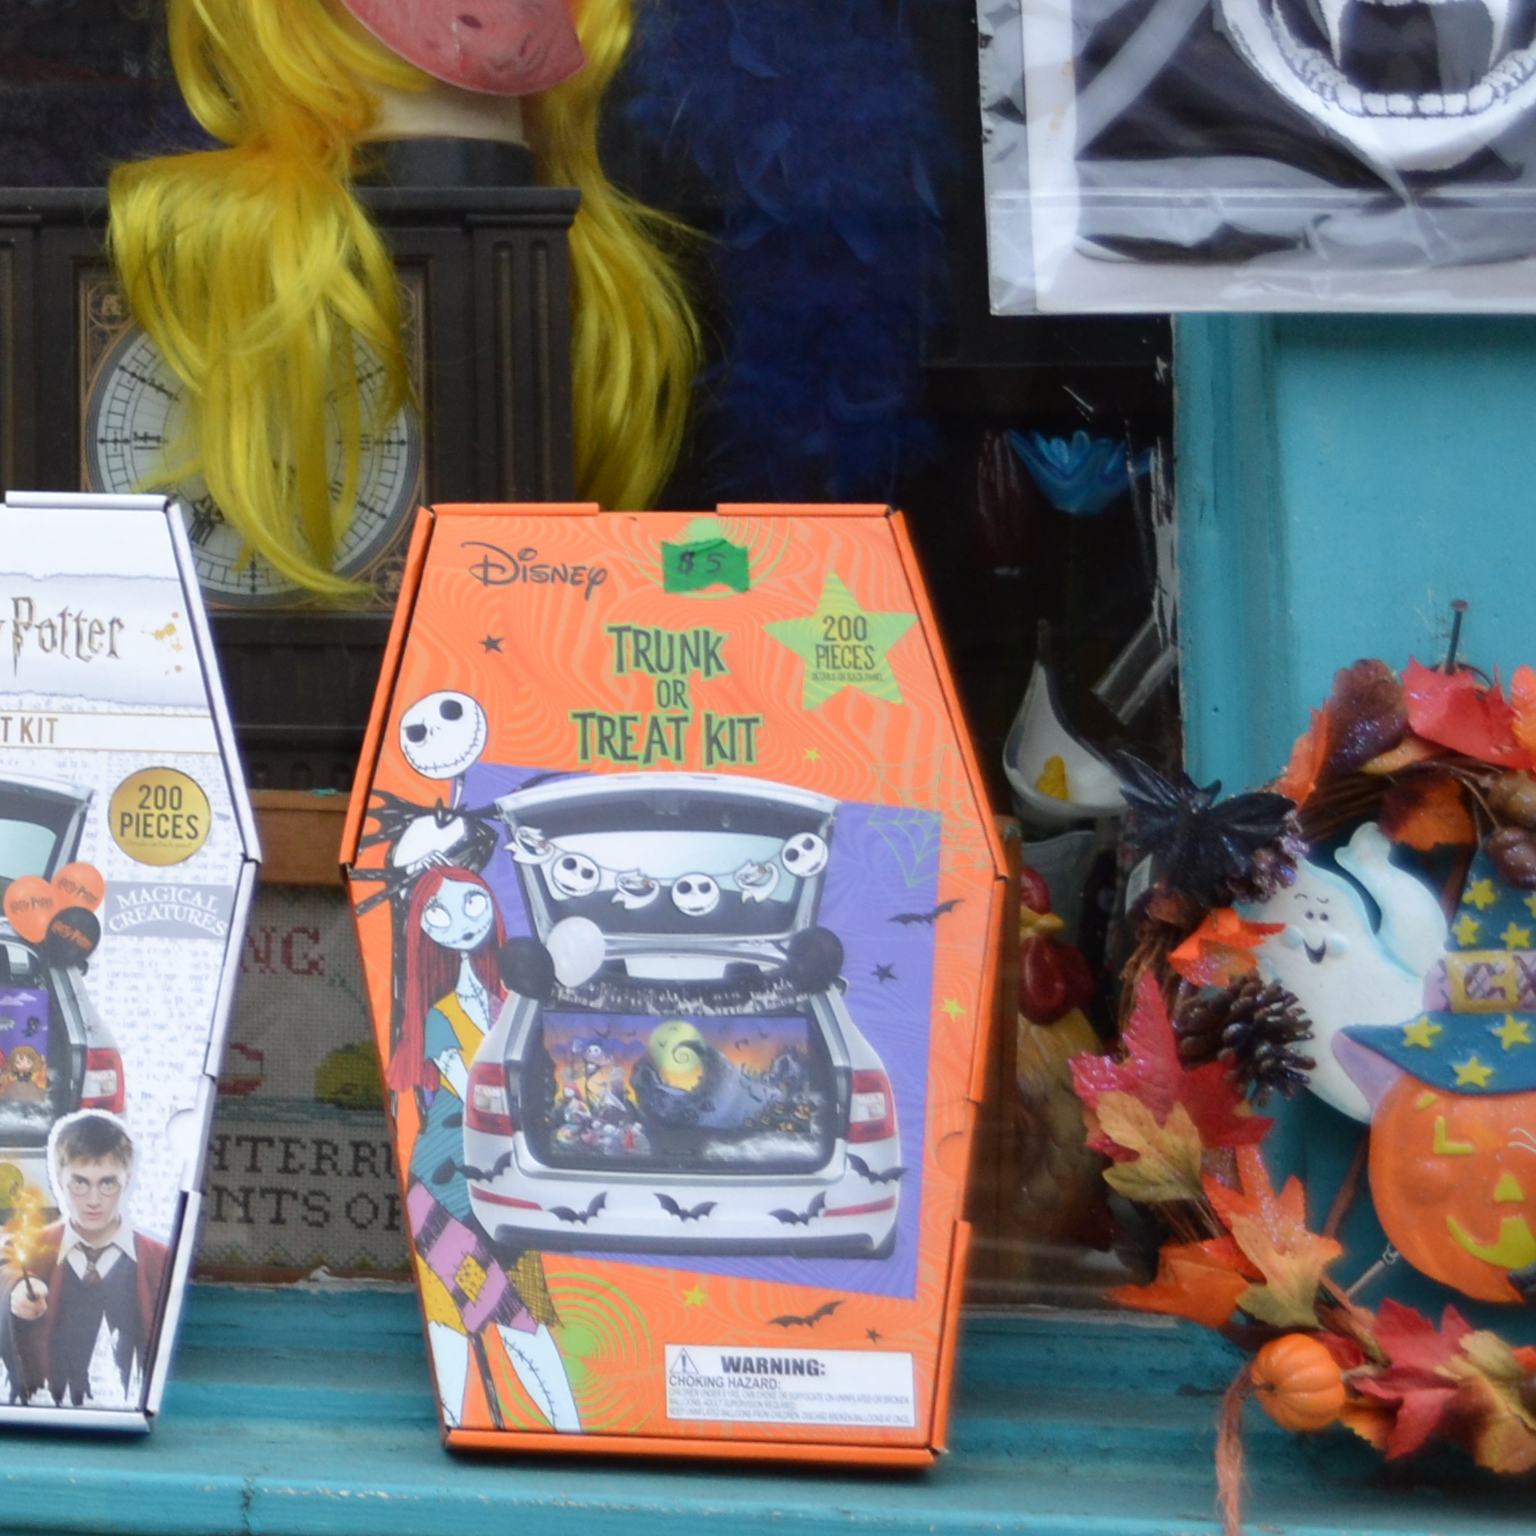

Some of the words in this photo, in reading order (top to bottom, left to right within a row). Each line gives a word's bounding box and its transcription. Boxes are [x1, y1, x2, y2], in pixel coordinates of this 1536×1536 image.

[461, 541, 608, 600] Disney
[9, 595, 126, 678] Potter
[823, 615, 867, 642] 200
[608, 624, 726, 676] TRUNK
[816, 644, 875, 670] PIECES
[656, 678, 688, 710] OR
[20, 717, 59, 745] KIT
[571, 711, 688, 764] TREAT
[704, 712, 761, 765] KIT
[138, 784, 183, 811] 200
[120, 811, 199, 841] PIECES
[115, 885, 219, 917] MAGICAL
[109, 907, 230, 938] CREATURES
[720, 1354, 826, 1378] WARNING:
[669, 1375, 725, 1388] CHOKING
[728, 1377, 781, 1391] HAZARD:
